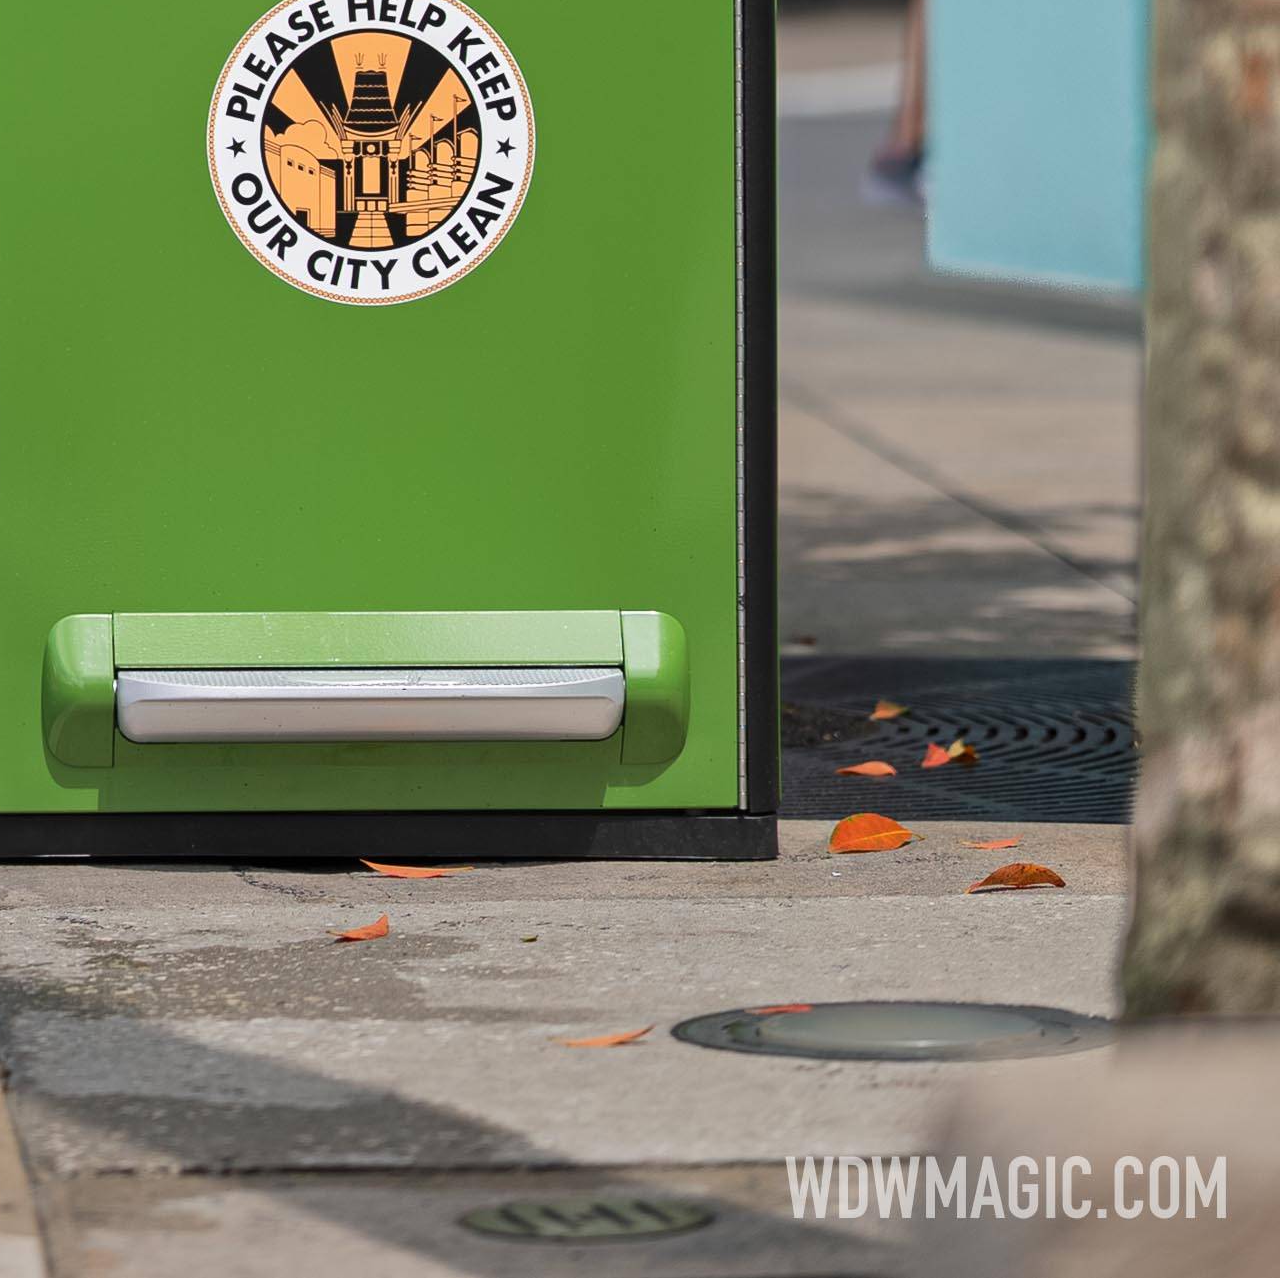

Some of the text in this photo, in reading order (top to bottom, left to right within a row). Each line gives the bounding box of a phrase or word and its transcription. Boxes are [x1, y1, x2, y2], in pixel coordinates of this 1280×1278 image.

[226, 0, 335, 122] PLEASE
[447, 26, 517, 121] KEEP
[231, 168, 515, 290] OUR CITY CLEAN
